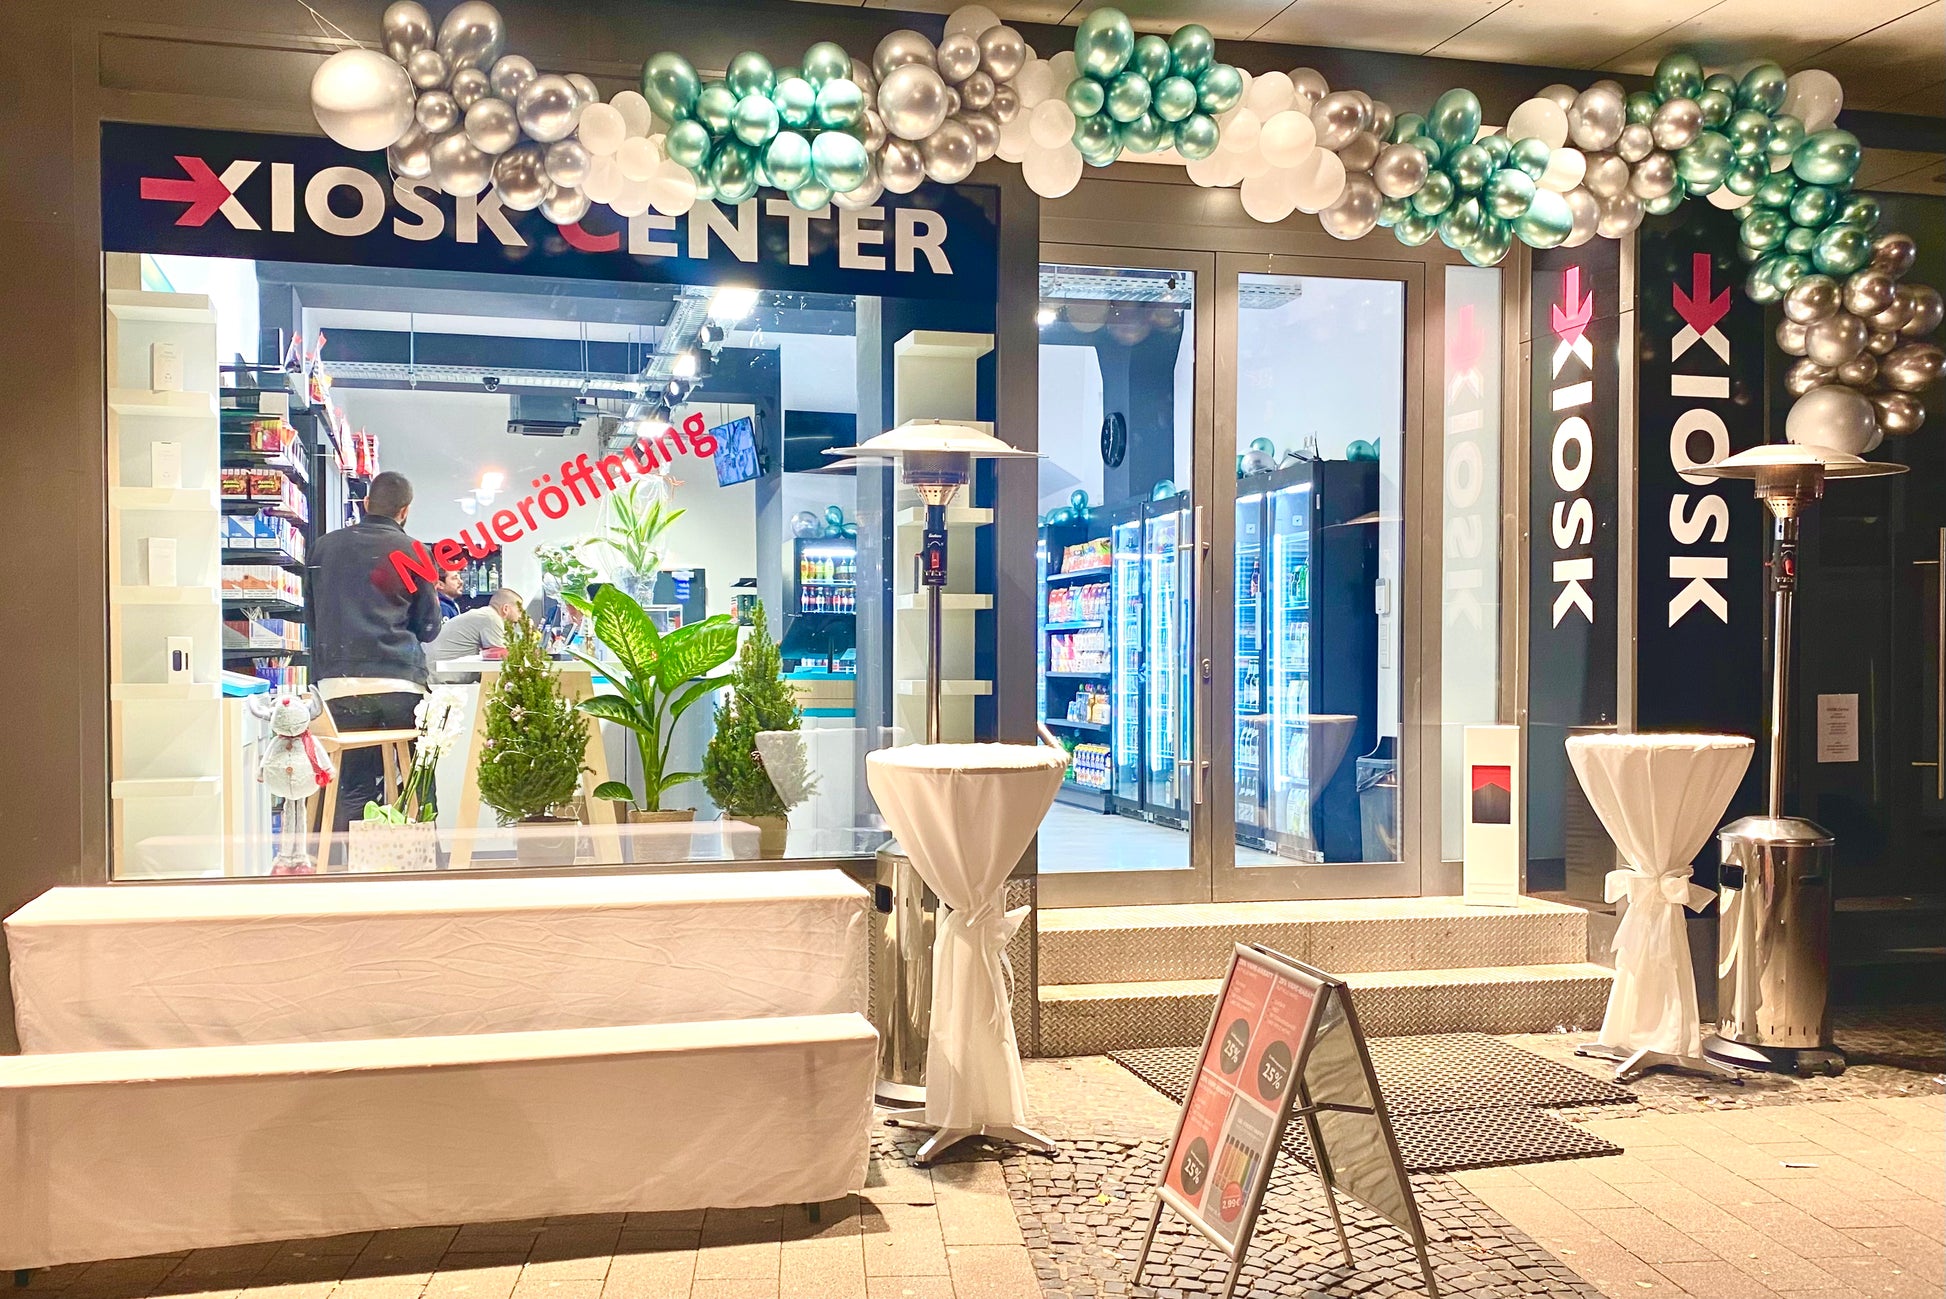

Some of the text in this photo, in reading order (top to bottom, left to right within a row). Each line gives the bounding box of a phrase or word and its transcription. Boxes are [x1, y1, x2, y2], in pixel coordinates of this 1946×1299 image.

[175, 155, 528, 248] KIOSK
[1551, 290, 1595, 629] KIOSK
[1667, 280, 1732, 629] KIOSK
[388, 411, 718, 595] Neueröffnung
[1223, 1039, 1241, 1064] 25%
[1262, 1062, 1283, 1090] 25%
[1184, 1157, 1202, 1185] 25%
